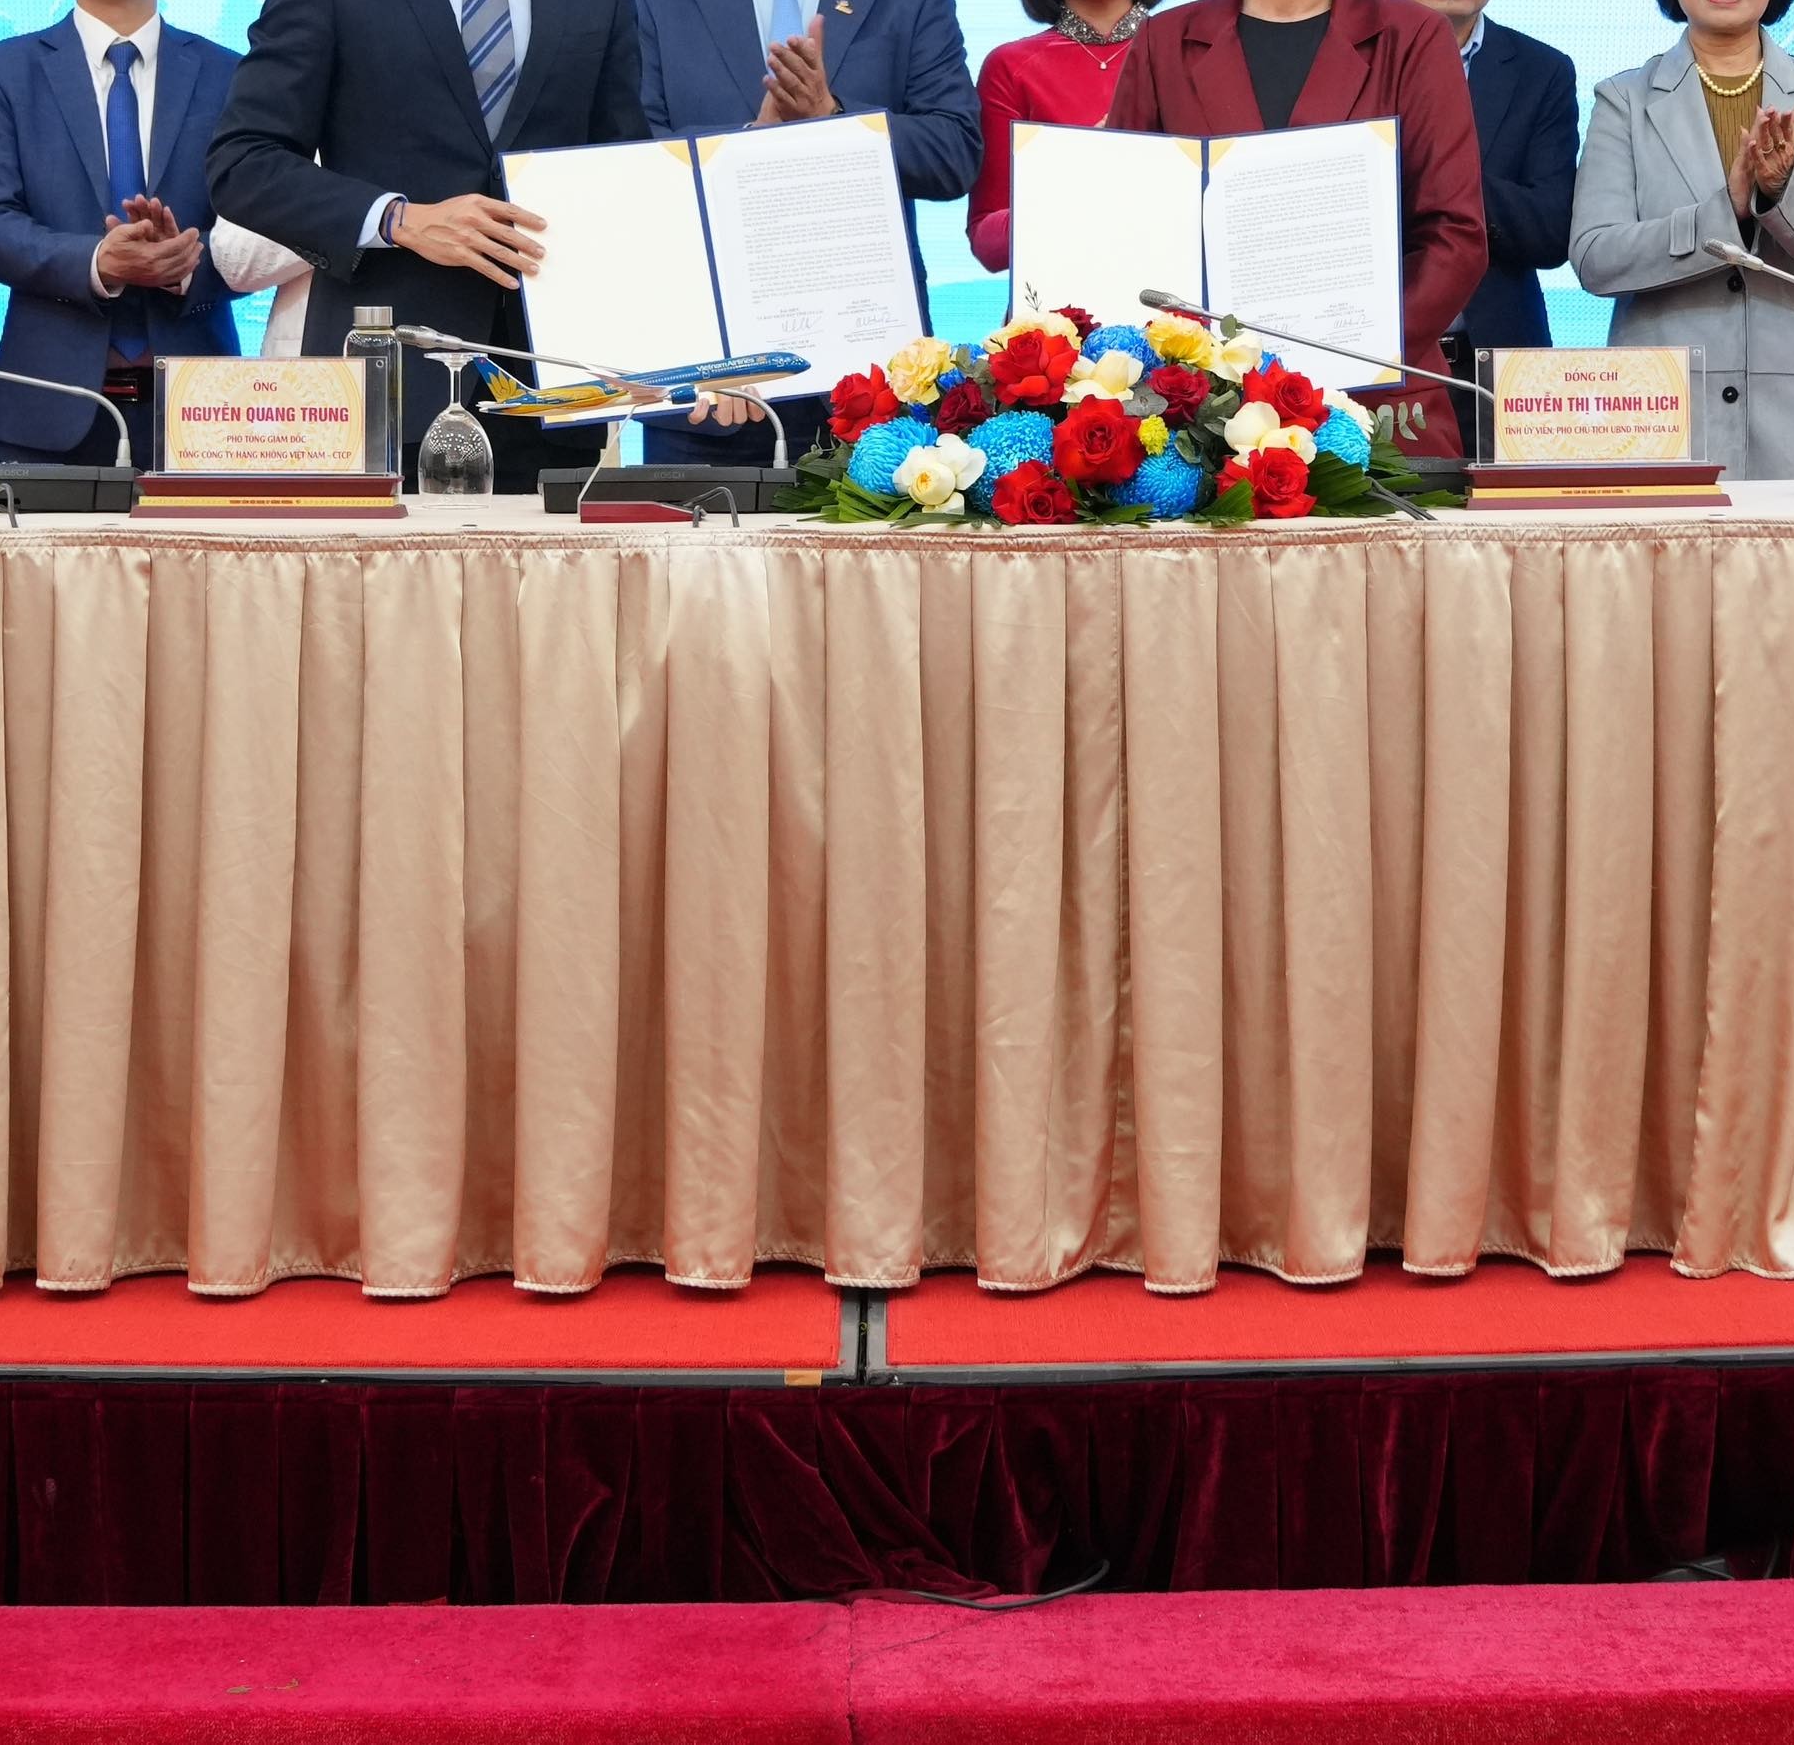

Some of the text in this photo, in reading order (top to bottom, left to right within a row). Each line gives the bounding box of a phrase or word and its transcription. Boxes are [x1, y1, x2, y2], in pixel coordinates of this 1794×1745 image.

[1599, 368, 1618, 382] CHÍ
[253, 379, 278, 392] ÔNG
[1503, 392, 1679, 415] NGUYỄN THỊ THANH LỊCH
[181, 402, 349, 423] NGUYỄN QUANG TRUNG
[333, 450, 351, 459] CTCP
